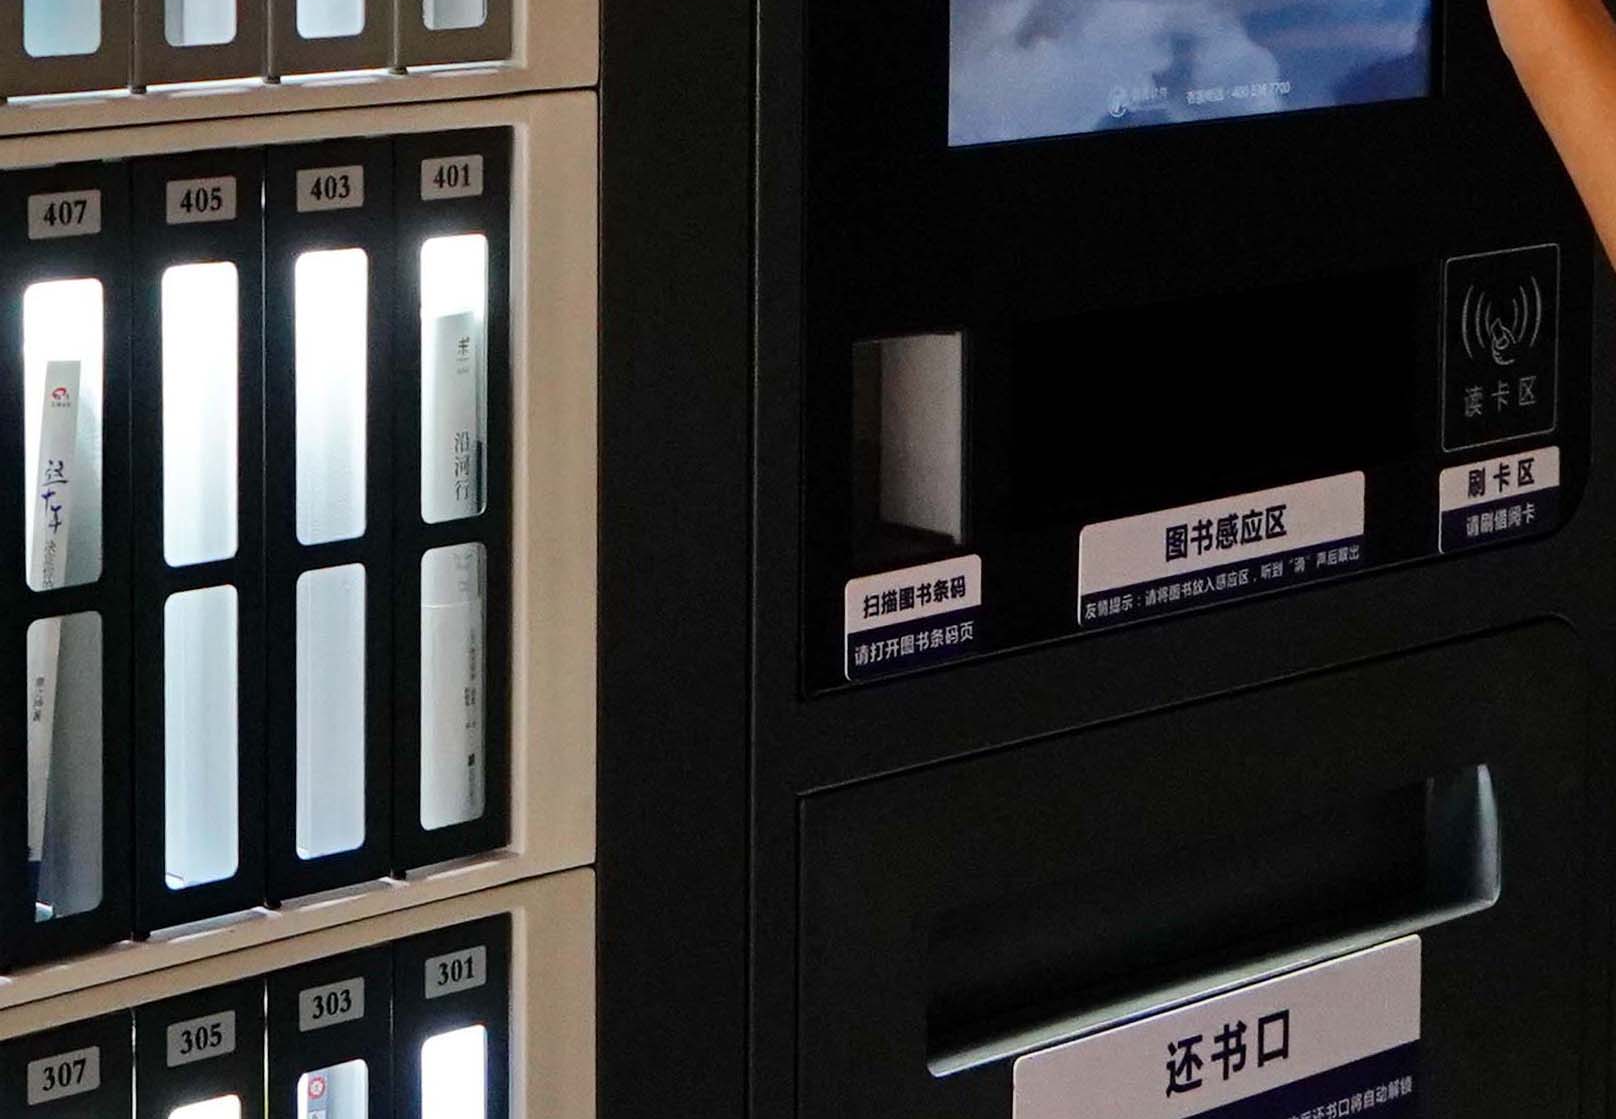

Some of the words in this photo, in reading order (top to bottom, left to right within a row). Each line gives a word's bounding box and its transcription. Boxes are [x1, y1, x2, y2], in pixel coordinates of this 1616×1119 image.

[309, 174, 351, 200] 403
[432, 164, 472, 189] 401
[42, 200, 88, 228] 407
[179, 186, 223, 214] 405
[1464, 375, 1537, 418] 读卡区
[1467, 457, 1536, 498] 刷卡区
[1165, 503, 1288, 563] 图书感应区
[863, 575, 966, 619] 扫描图书条码
[854, 620, 975, 666] 请打开图书条码页
[437, 956, 476, 986] 301
[311, 989, 353, 1019] 303
[180, 1022, 223, 1054] 305
[1165, 1008, 1290, 1098] 还书口
[41, 1058, 87, 1091] 307
